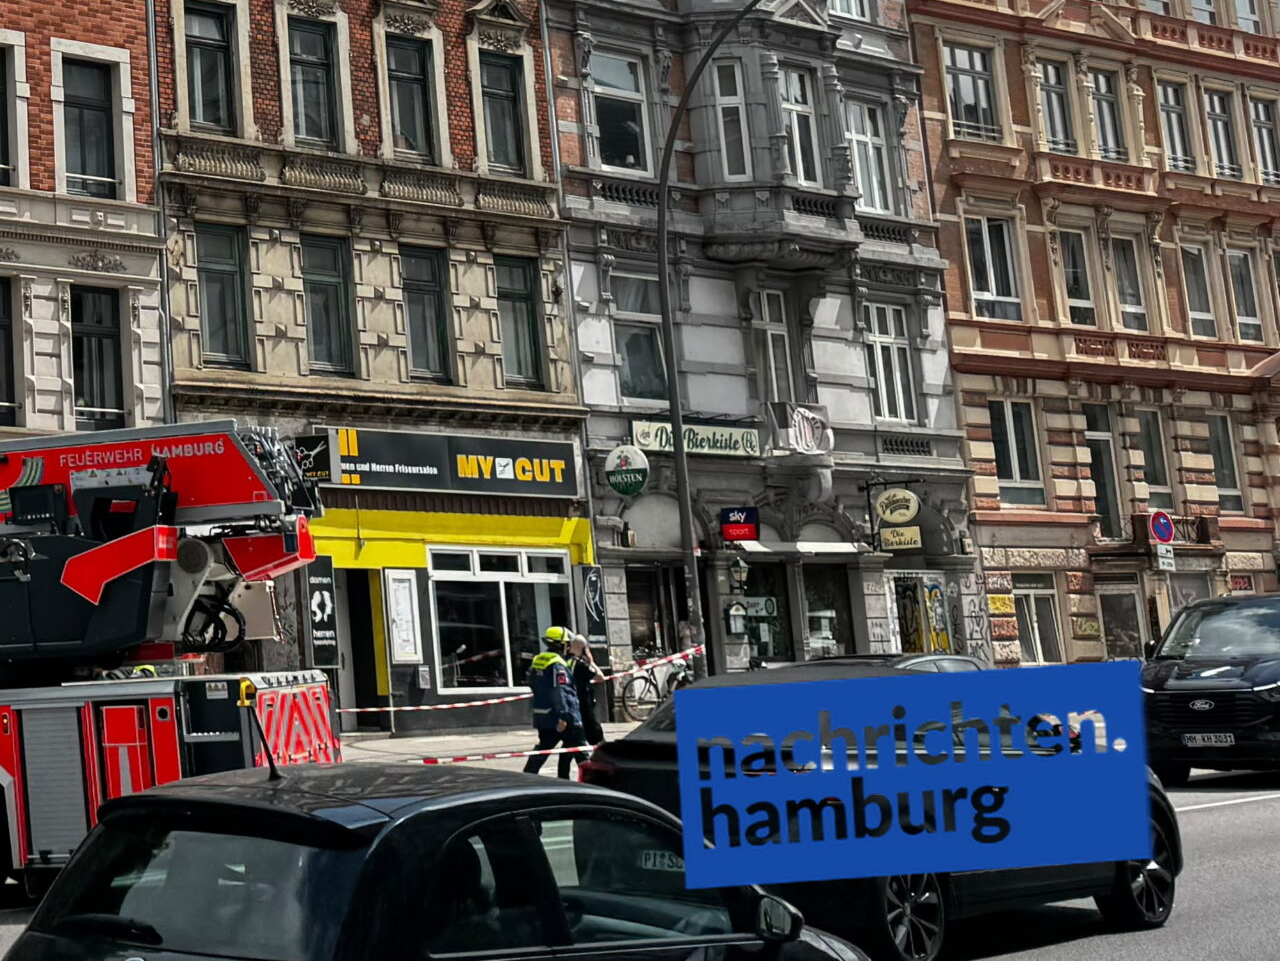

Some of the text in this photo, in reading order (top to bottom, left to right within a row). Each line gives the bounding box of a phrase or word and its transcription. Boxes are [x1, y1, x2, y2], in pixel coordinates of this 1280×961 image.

[655, 426, 675, 448] Di
[683, 427, 741, 451] Bierkiste
[59, 447, 143, 467] FEUERWEHR
[356, 462, 370, 471] und
[371, 462, 395, 473] Herren
[456, 454, 565, 482] MY CUT
[609, 472, 643, 483] HOLSTEN
[729, 510, 746, 523] sky
[729, 527, 749, 536] sport
[309, 576, 332, 584] damen
[312, 629, 336, 638] herren
